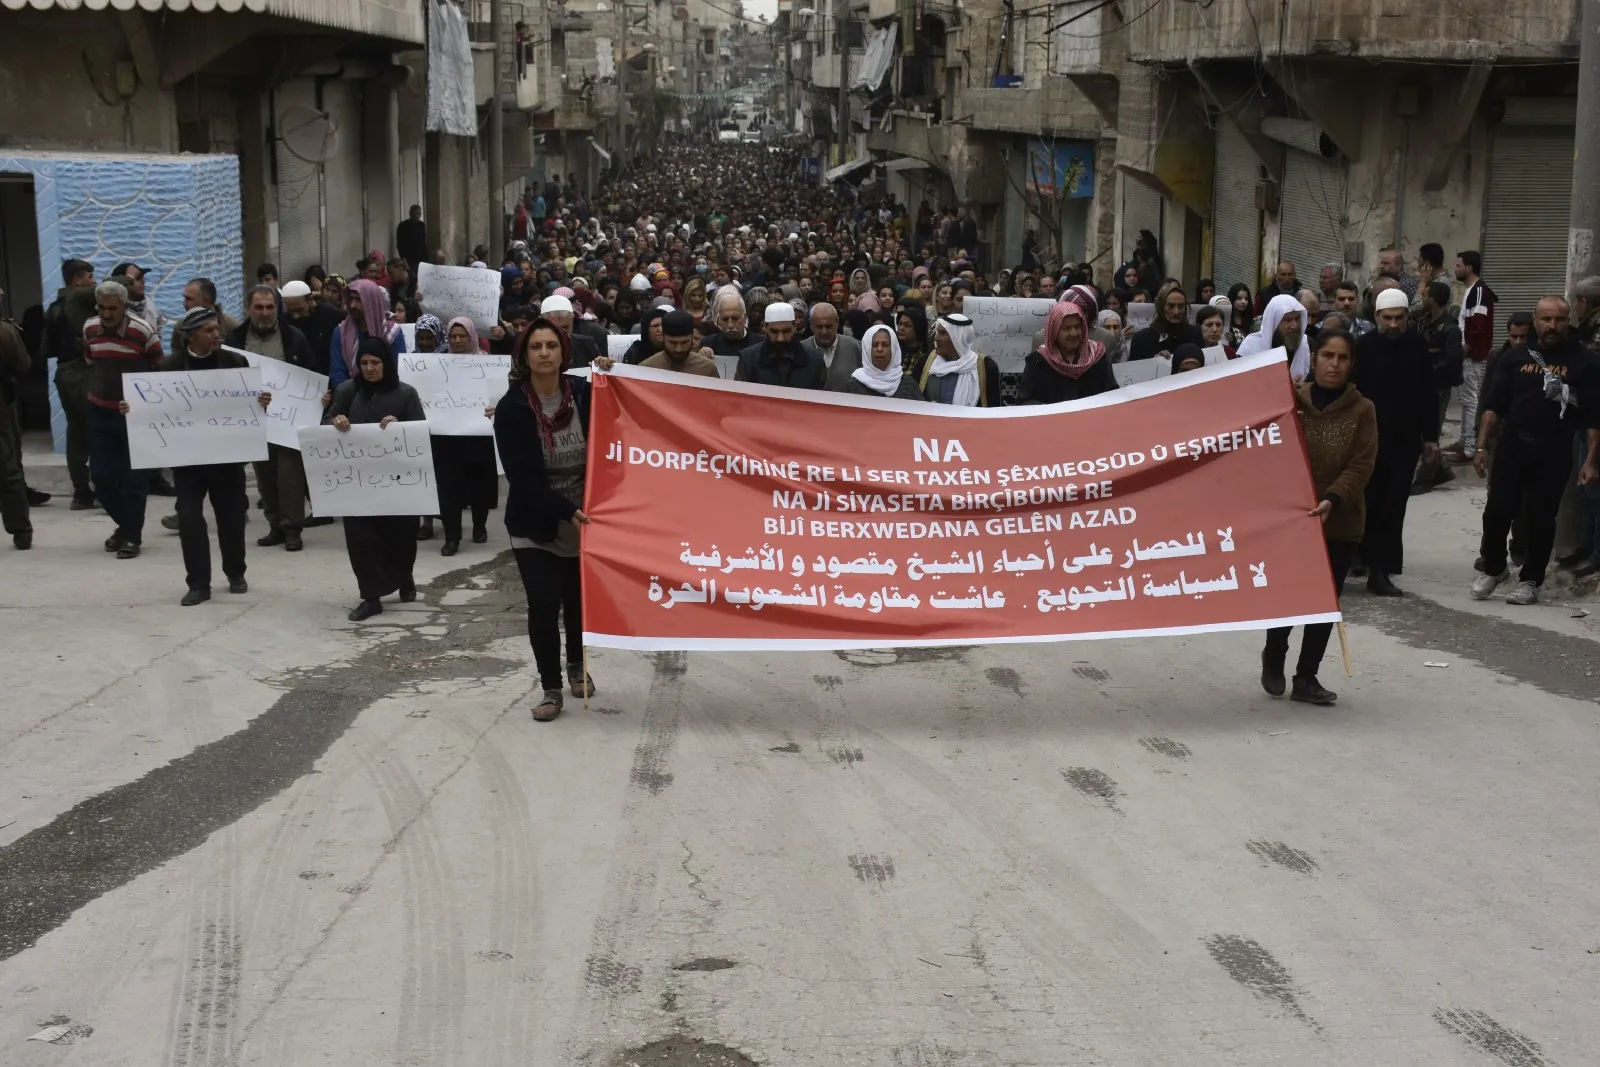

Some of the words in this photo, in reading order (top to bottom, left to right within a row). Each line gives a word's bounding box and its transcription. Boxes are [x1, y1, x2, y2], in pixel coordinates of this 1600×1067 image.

[403, 357, 428, 372] Na
[207, 404, 260, 427] azad
[913, 437, 970, 462] NA
[806, 464, 836, 482] RE
[866, 469, 911, 485] SER
[912, 467, 991, 486] TAXÊN
[996, 451, 1146, 487] ŞÊXMEQSÛD
[1150, 444, 1168, 461] Û
[772, 489, 807, 510] NA
[1084, 480, 1113, 500] RE
[810, 520, 980, 538] BERXWEDANA
[985, 511, 1063, 536] GELÊN
[1068, 506, 1137, 530] AZAD
[1119, 530, 1207, 569] للحصار
[1216, 526, 1236, 552] لا
[679, 541, 785, 574] الأشرفية
[789, 554, 806, 577] و
[812, 551, 898, 579] مقصود
[906, 549, 984, 581] الشيخ
[991, 539, 1055, 577] أحياء
[1062, 542, 1113, 574] على
[1142, 565, 1239, 600] لسياسة
[1249, 561, 1268, 588] لا
[648, 575, 716, 610] الحرة
[724, 583, 827, 611] الشعوب
[833, 584, 921, 614] مقاومة
[929, 585, 1006, 609] عاشت
[1037, 575, 1136, 613] التجويع
